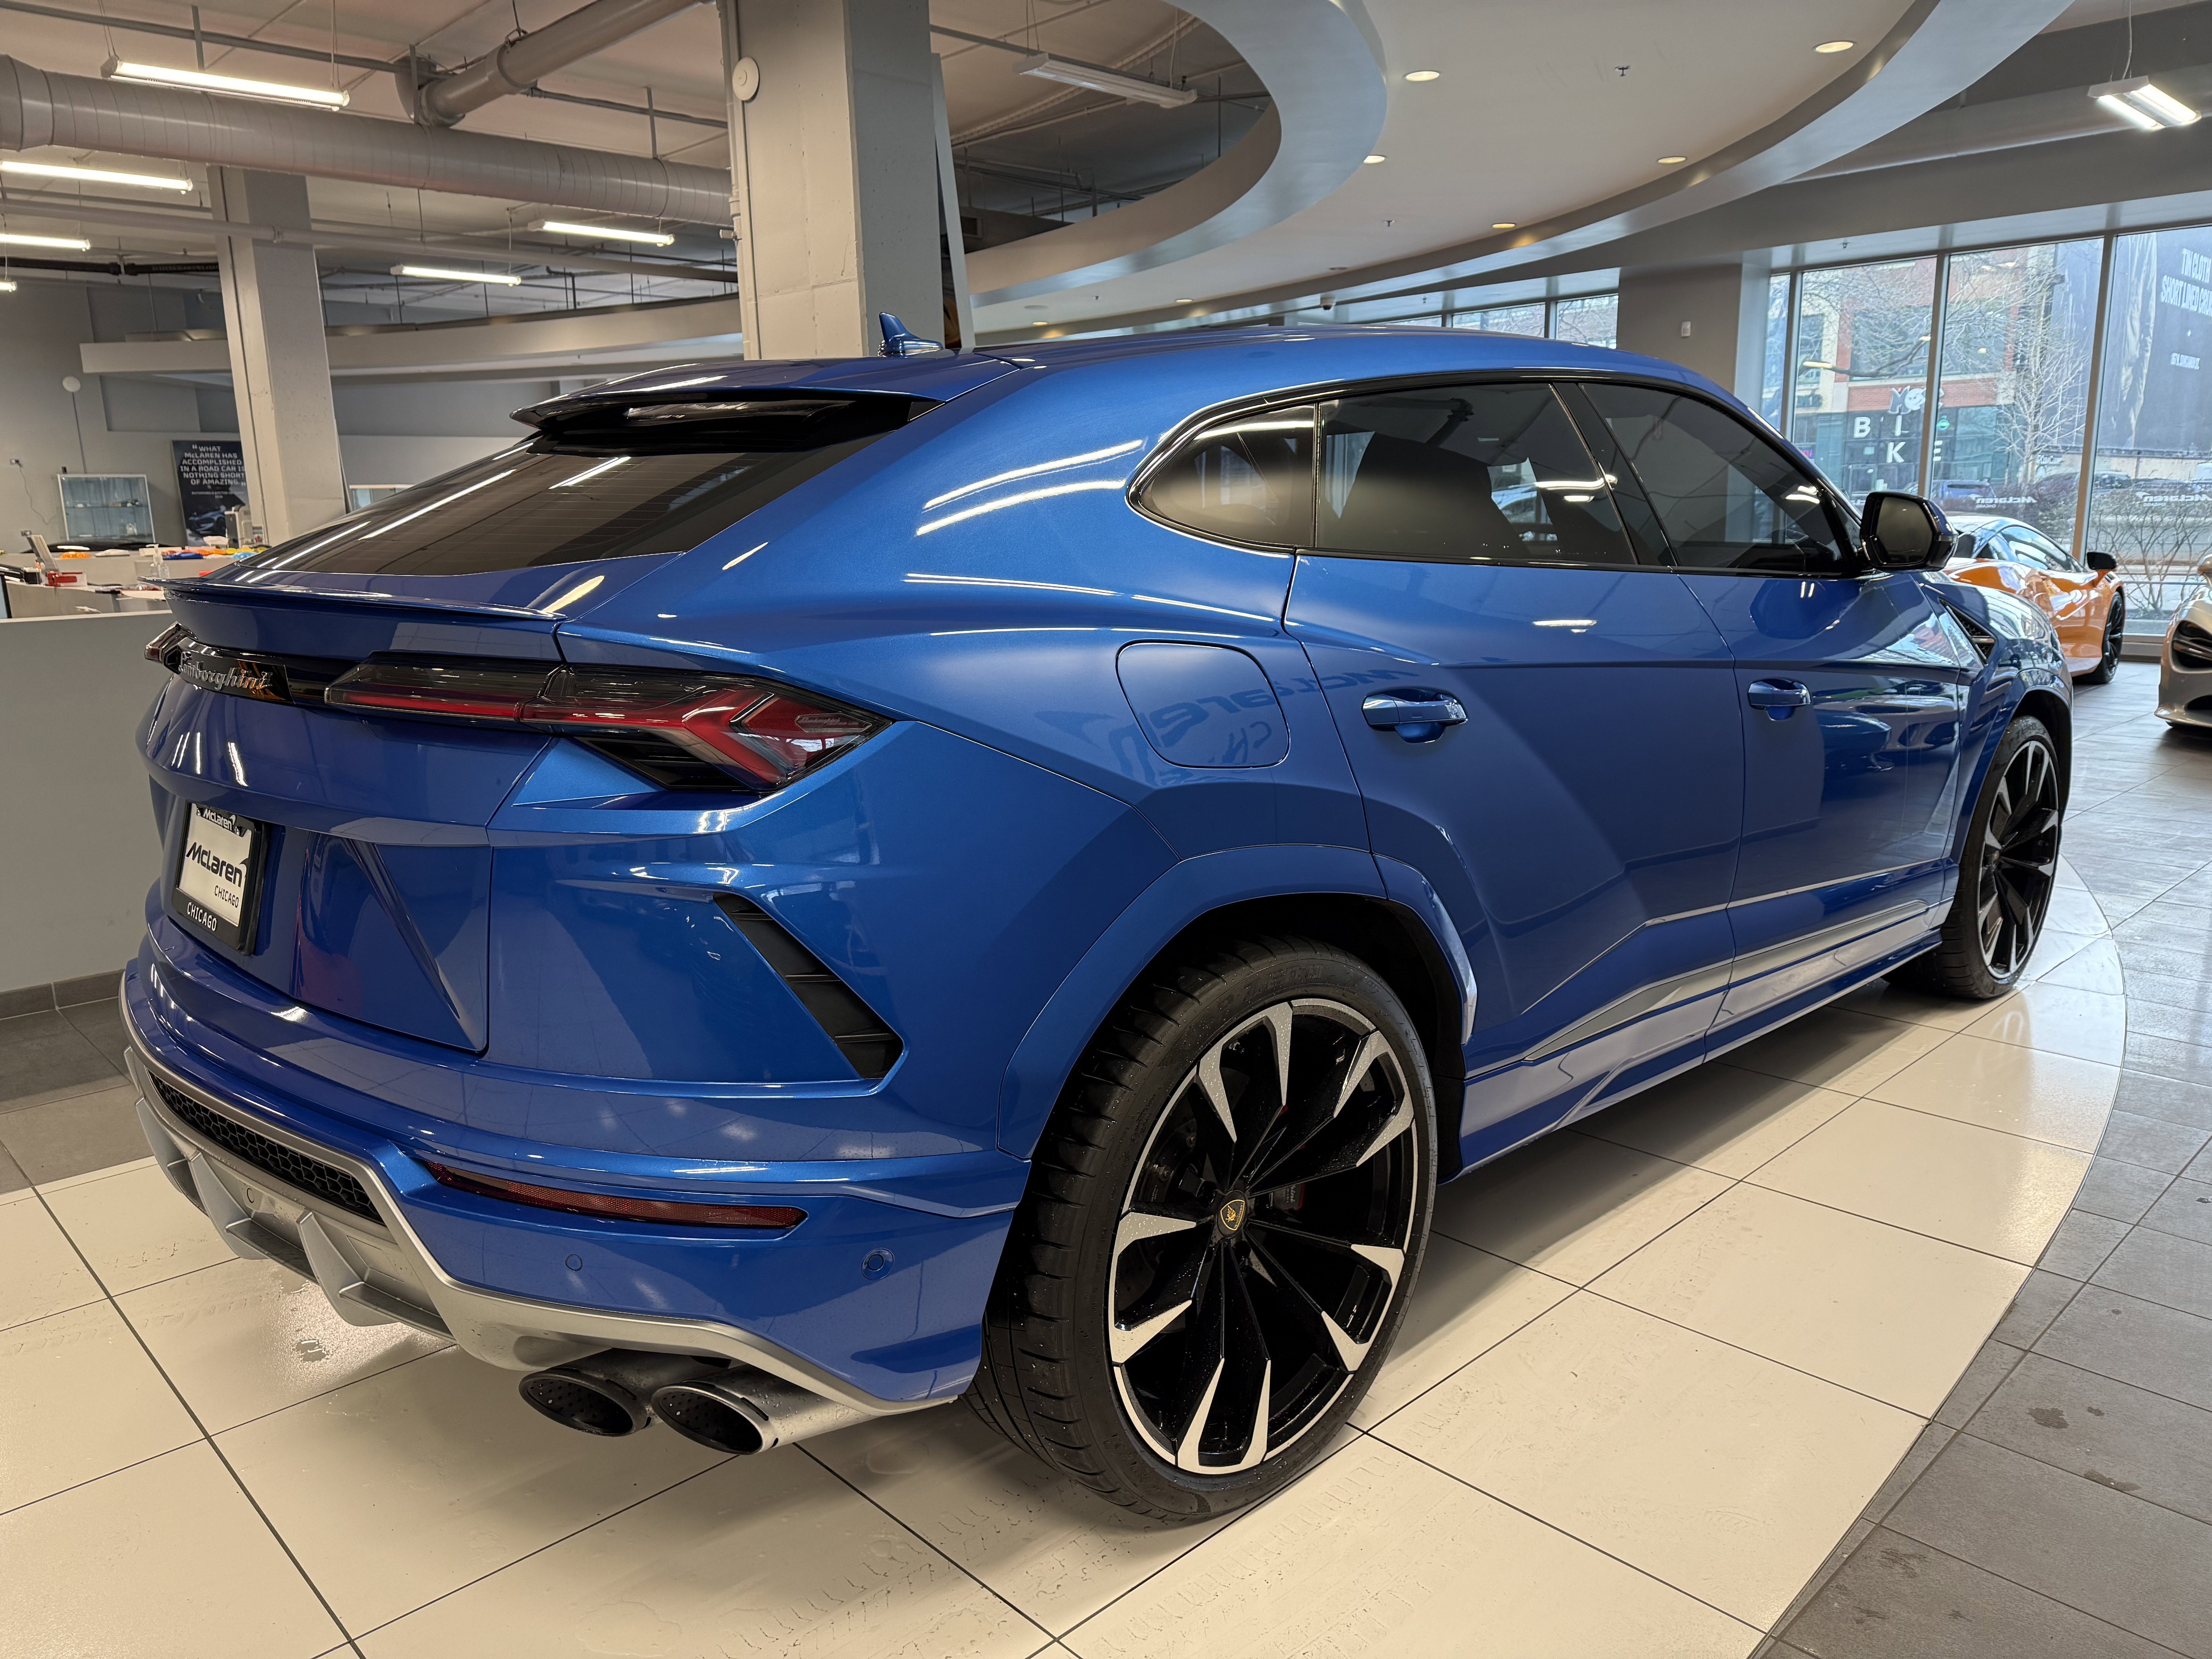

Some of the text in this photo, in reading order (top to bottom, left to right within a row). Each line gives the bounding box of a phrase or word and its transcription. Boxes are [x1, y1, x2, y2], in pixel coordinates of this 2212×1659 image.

[2181, 248, 2212, 283] TIN CLOTH
[2160, 275, 2184, 307] SHORT
[2181, 282, 2200, 312] LINED
[179, 651, 273, 690] Lamborghini
[203, 808, 232, 831] McLaren
[186, 842, 242, 887] McLaren
[214, 885, 239, 908] CHICAGO
[187, 902, 217, 931] CHICAGO
